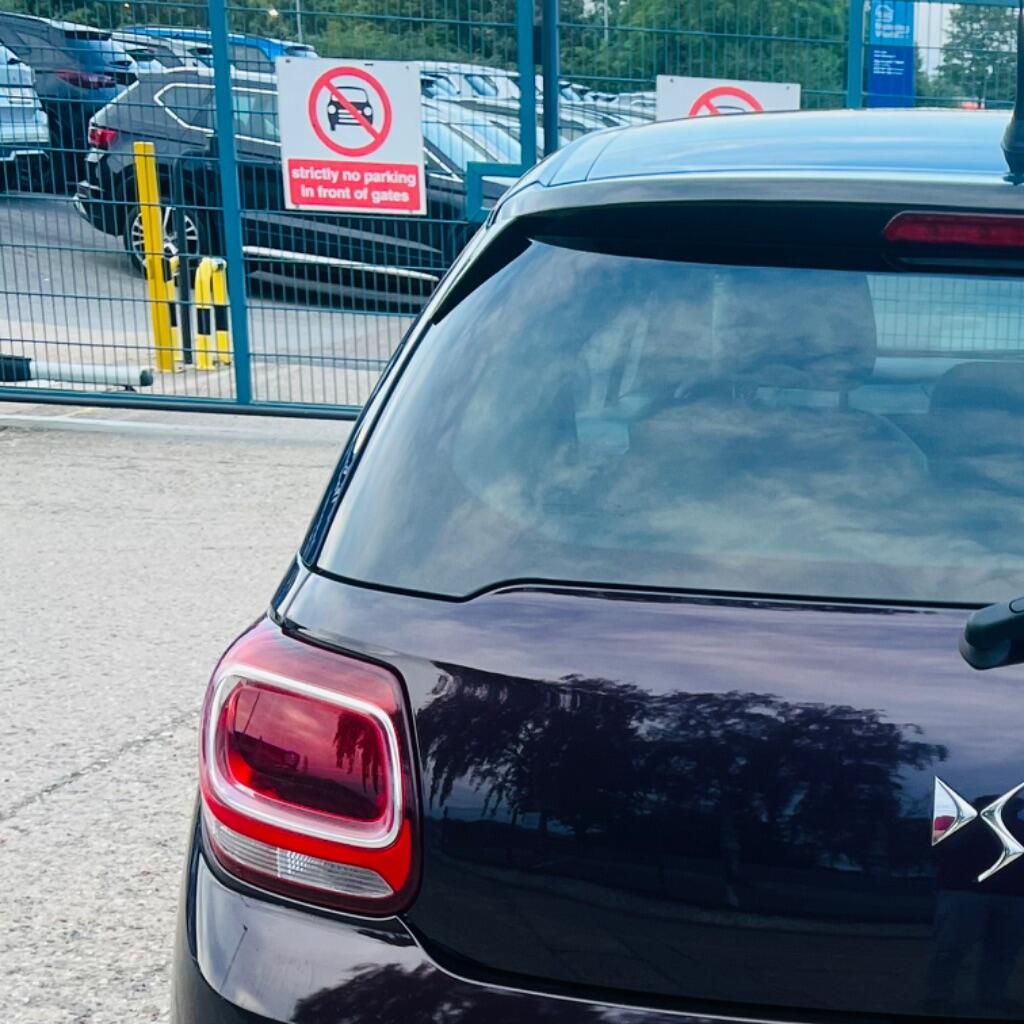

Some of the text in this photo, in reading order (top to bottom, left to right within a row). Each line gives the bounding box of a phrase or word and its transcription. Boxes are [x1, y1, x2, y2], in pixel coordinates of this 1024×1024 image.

[291, 166, 417, 187] strictly no parking
[301, 184, 409, 203] in front of gates
